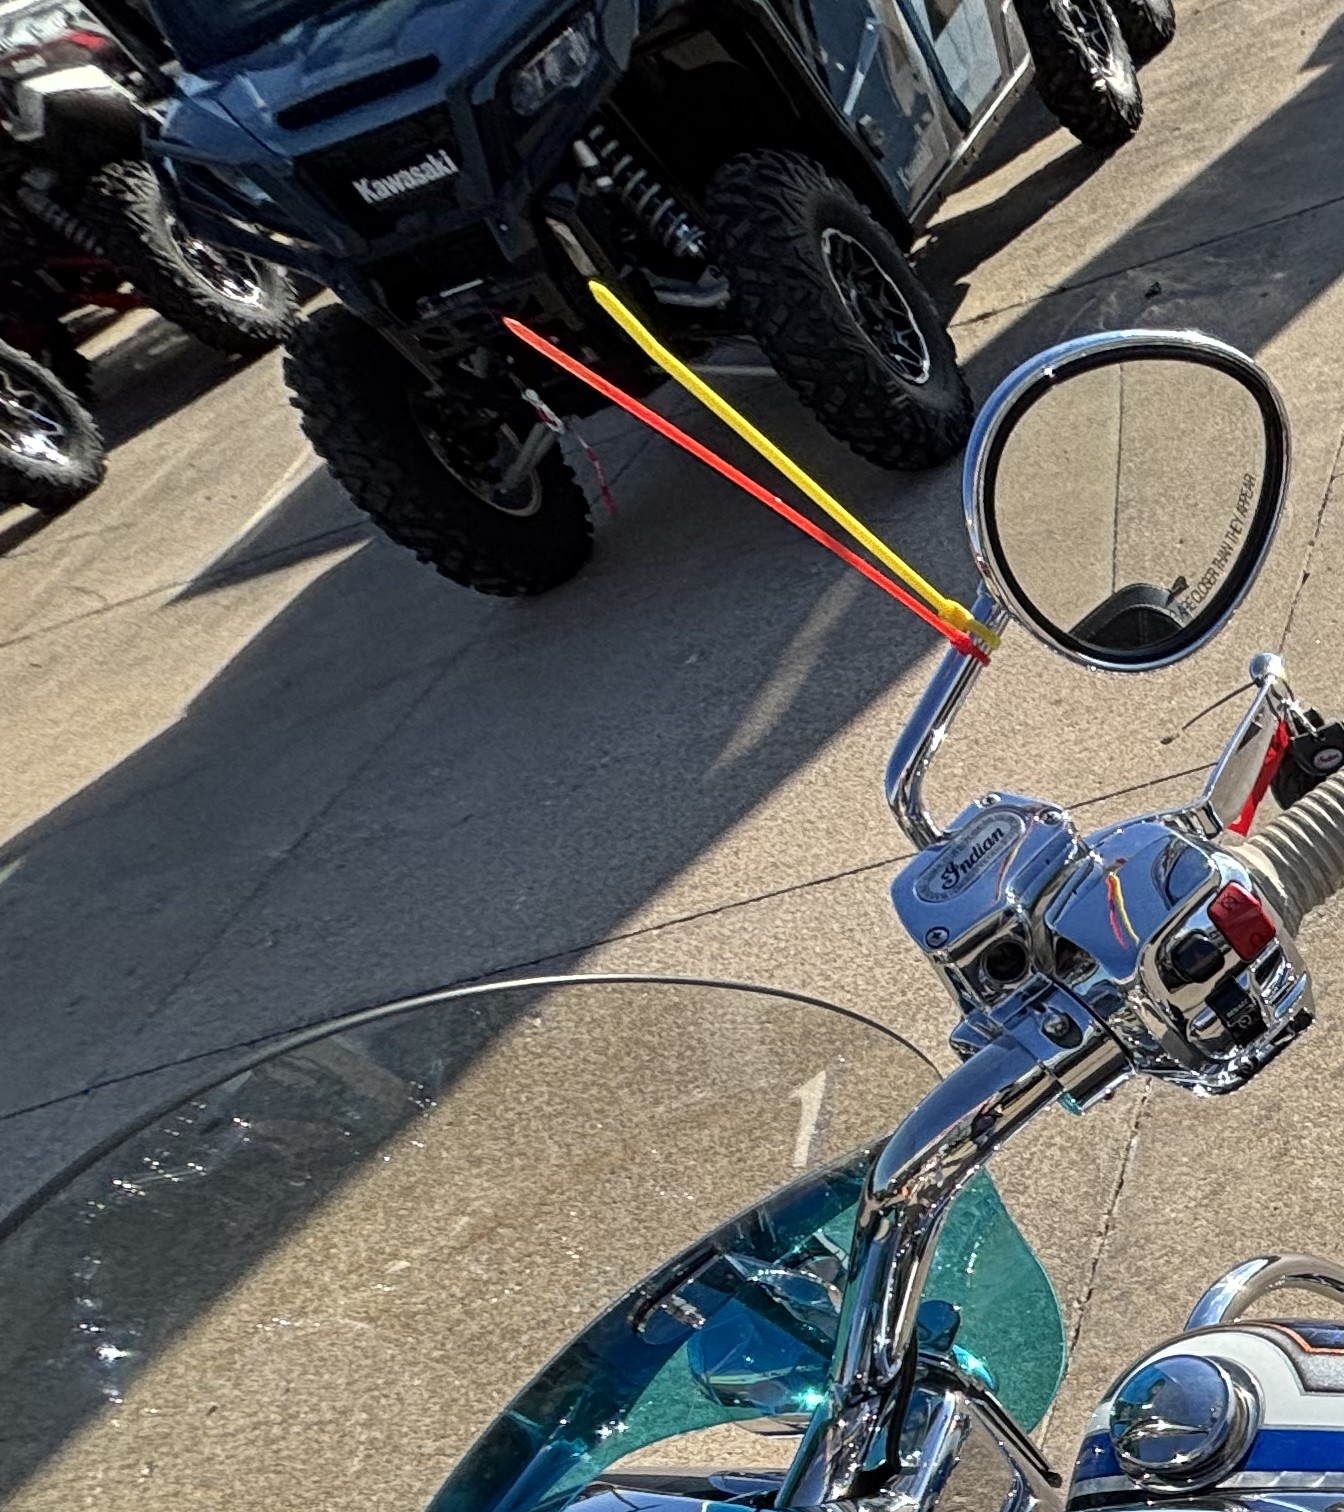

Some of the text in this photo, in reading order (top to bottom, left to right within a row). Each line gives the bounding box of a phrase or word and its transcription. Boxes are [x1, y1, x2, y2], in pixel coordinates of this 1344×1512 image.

[351, 149, 459, 204] Kawasaki
[1212, 541, 1234, 572] THAN
[1226, 513, 1245, 544] THEY
[1236, 472, 1257, 519] APPEAR
[940, 827, 1005, 891] Indian
